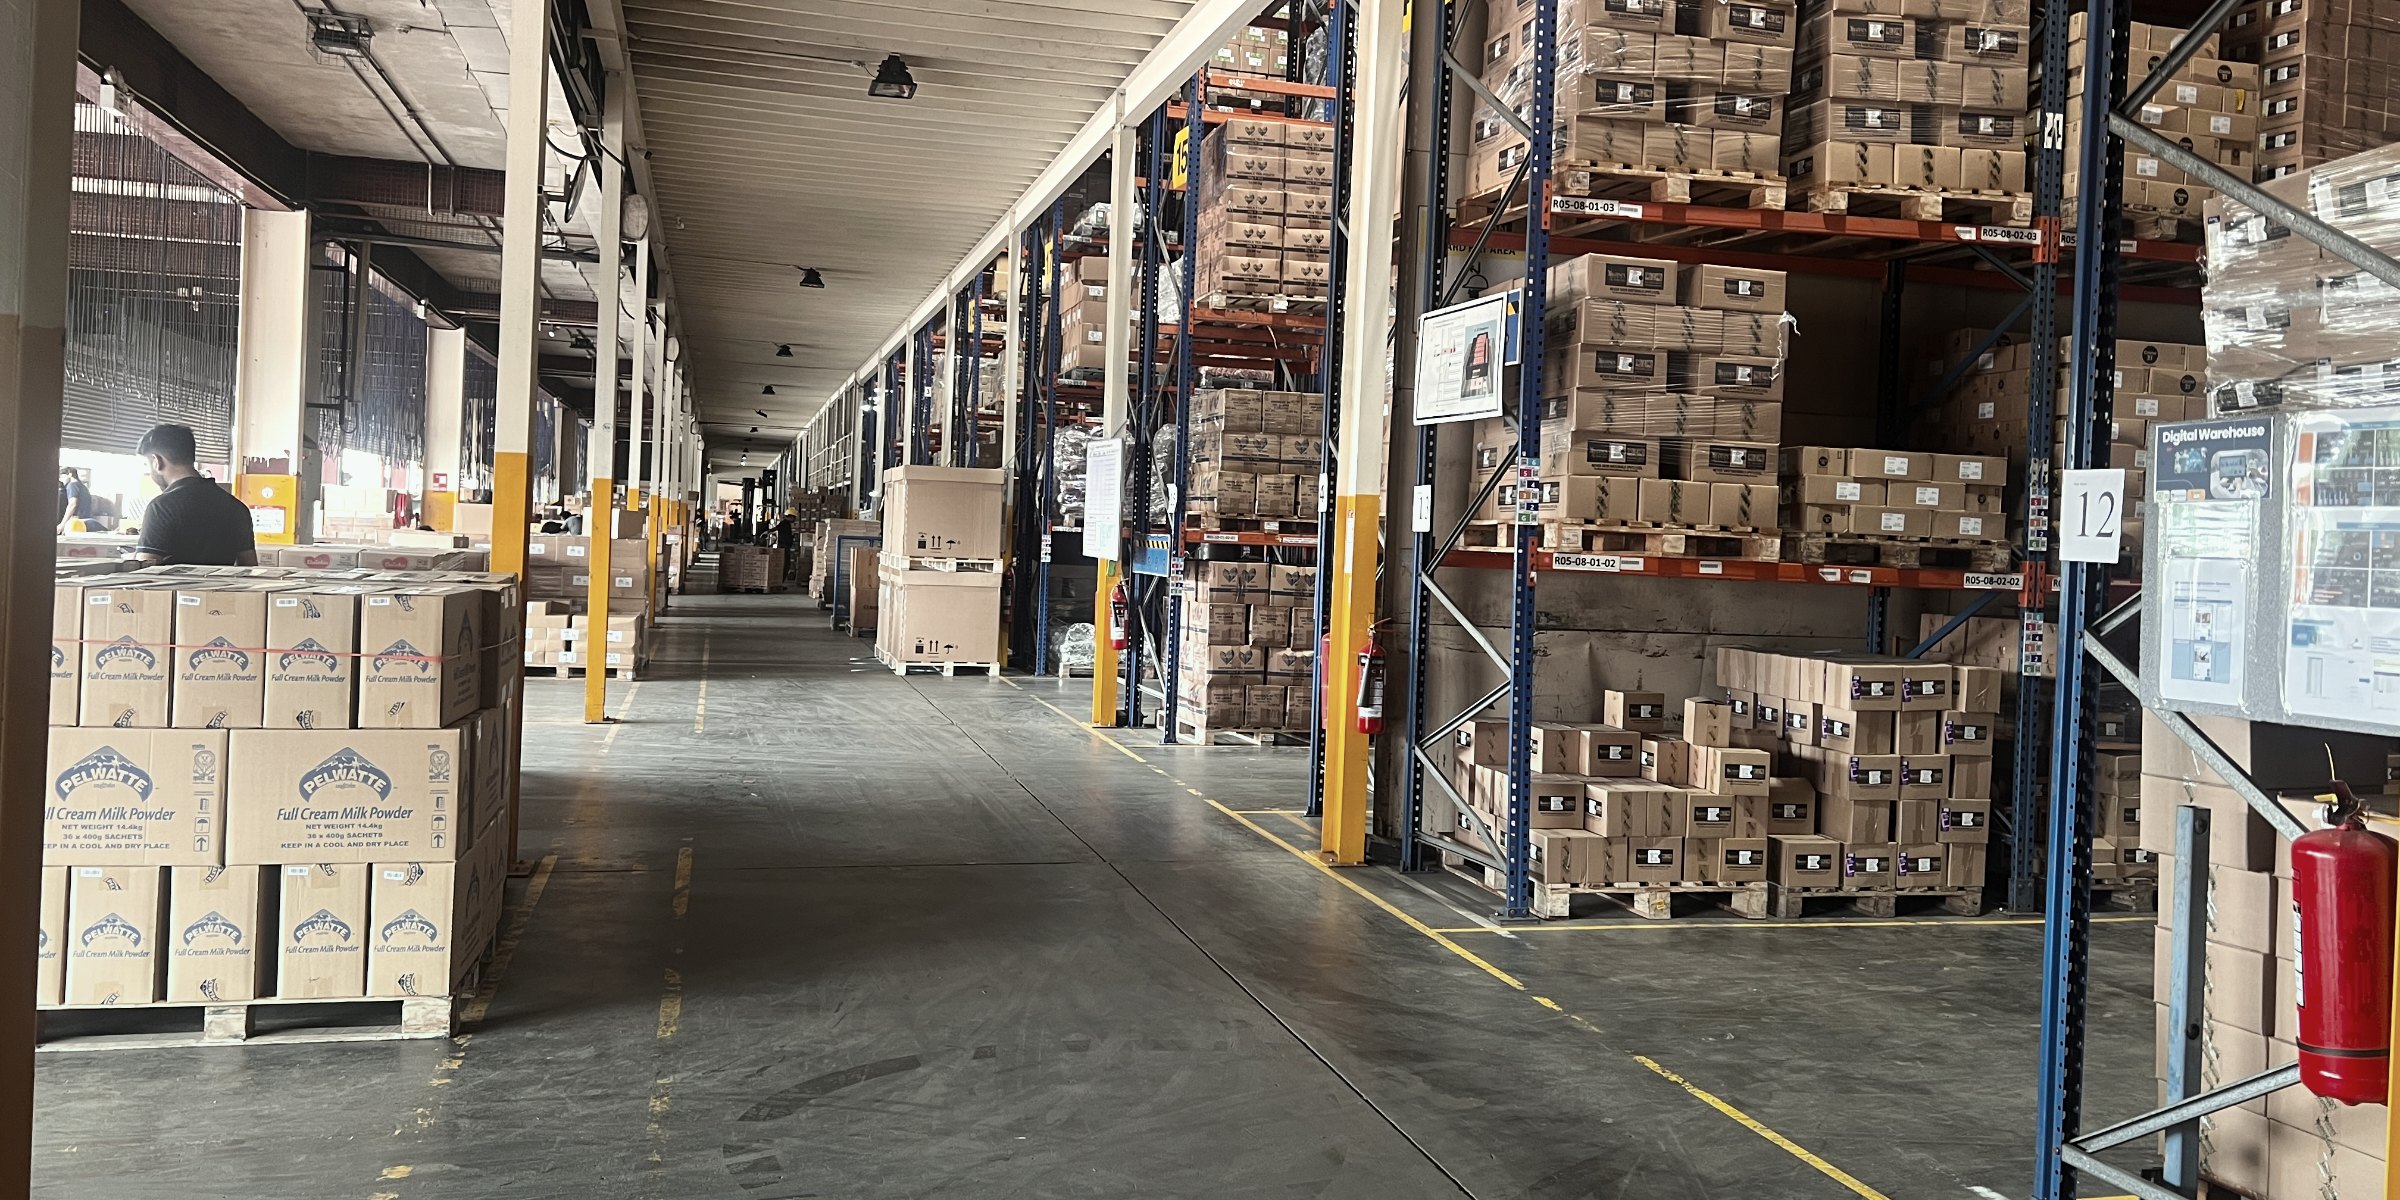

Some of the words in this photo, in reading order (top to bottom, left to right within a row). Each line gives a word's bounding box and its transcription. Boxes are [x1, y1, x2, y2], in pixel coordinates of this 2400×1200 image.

[1177, 139, 1188, 175] 15
[1553, 199, 1614, 211] R05-08-01-03
[1982, 228, 2037, 240] R05-08-02-03
[2162, 429, 2198, 446] Digital
[2198, 426, 2265, 440] Warehouse
[2076, 491, 2115, 537] 12
[1554, 556, 1616, 567] R05-08-01-02
[1965, 575, 2020, 586] R05-08-02-02
[98, 648, 153, 666] PELWATTE
[192, 650, 246, 667] PELWATTE
[282, 651, 335, 669] PELWATTE
[87, 672, 101, 680] Full
[101, 673, 122, 681] Cream
[122, 673, 138, 681] Milk
[138, 673, 164, 681] Powder
[181, 673, 194, 681] Full
[216, 673, 232, 681] Milk
[232, 673, 257, 681] Powder
[271, 674, 283, 682] Full
[283, 674, 305, 682] Cream
[305, 674, 320, 682] Milk
[321, 675, 346, 683] Powder
[365, 675, 377, 683] Full
[398, 675, 413, 683] Milk
[413, 676, 437, 684] Powder
[59, 768, 148, 794] PELWATTE
[303, 769, 387, 794] PELWATTE
[56, 808, 96, 820] Cream
[99, 807, 127, 820] Milk
[129, 807, 176, 821] Powder
[277, 808, 299, 820] Full
[300, 808, 339, 820] Cream
[340, 807, 367, 820] Milk
[369, 806, 413, 819] Powder
[84, 924, 139, 943] PELWATTE
[186, 923, 239, 941] PELWATTE
[296, 921, 349, 938] PELWATTE
[384, 921, 435, 938] PELWATTE
[39, 951, 57, 959] wder
[335, 944, 359, 952] Powder
[385, 945, 407, 953] Cream
